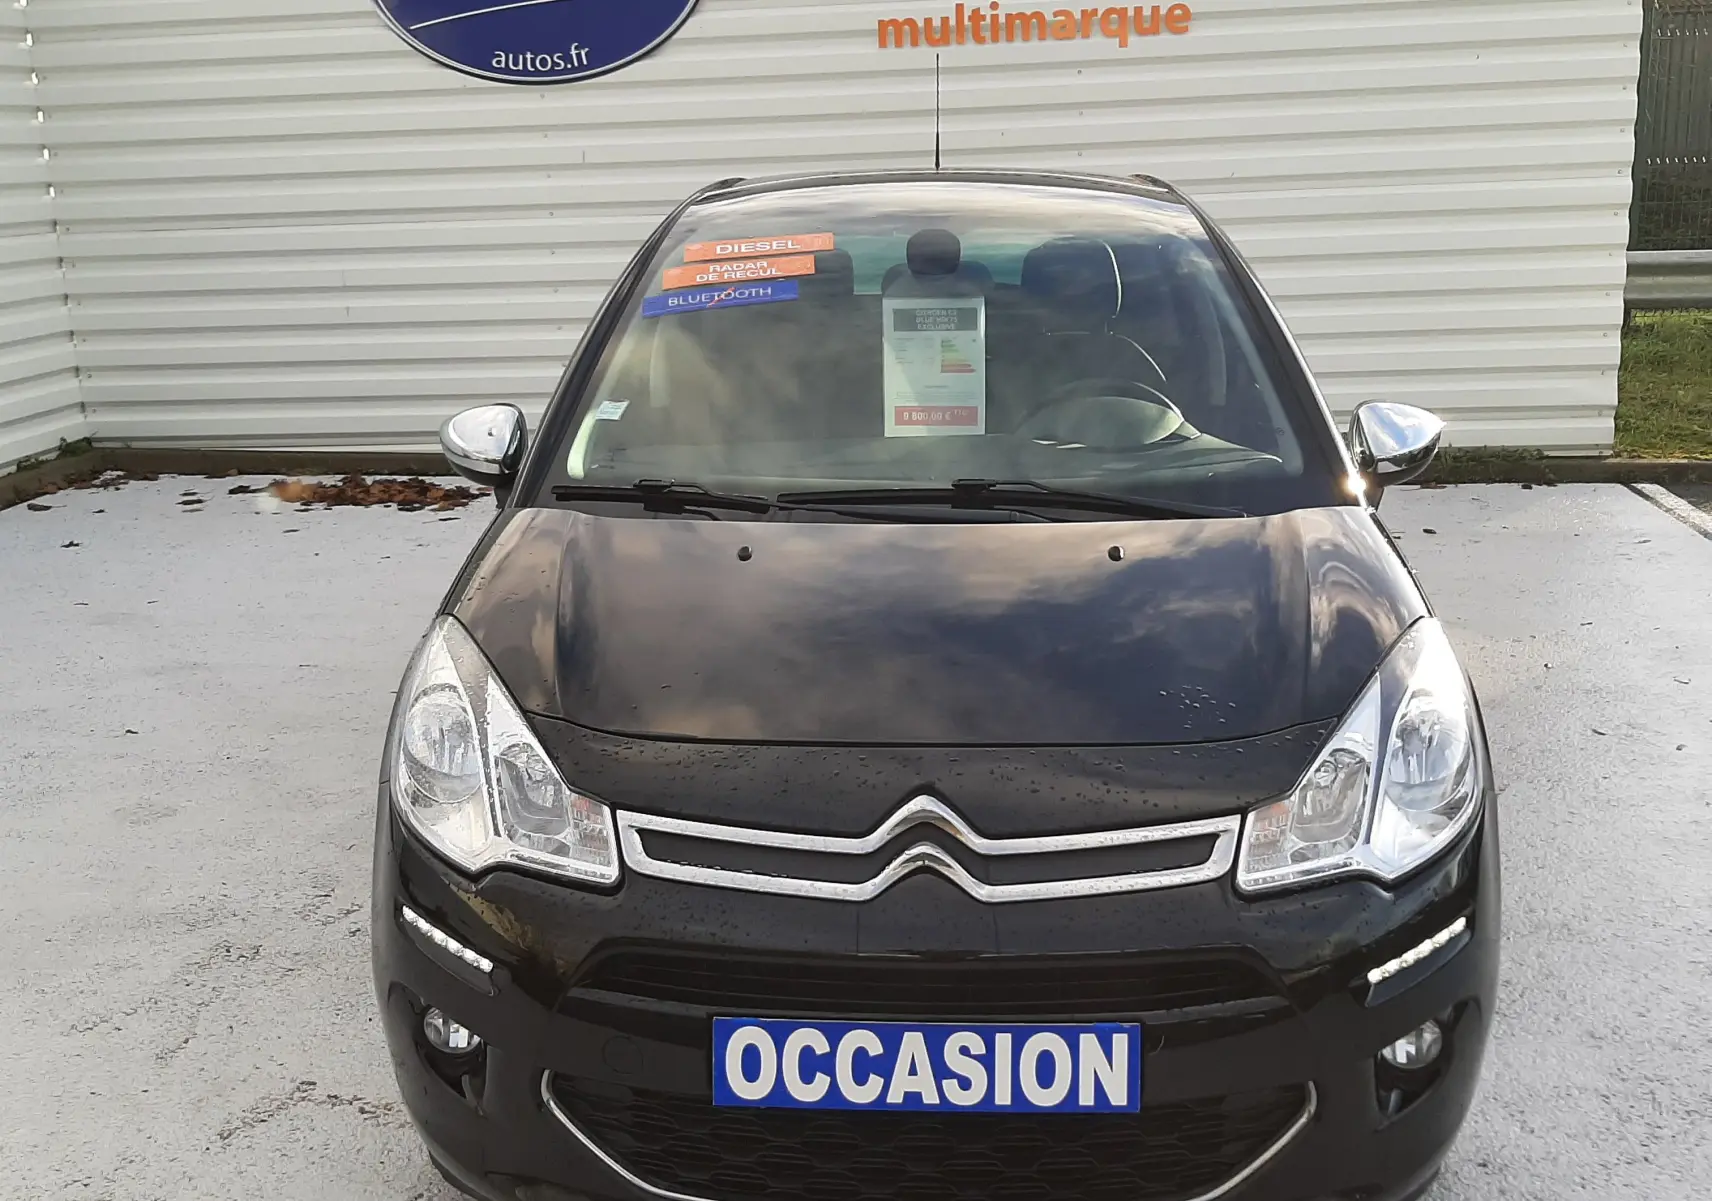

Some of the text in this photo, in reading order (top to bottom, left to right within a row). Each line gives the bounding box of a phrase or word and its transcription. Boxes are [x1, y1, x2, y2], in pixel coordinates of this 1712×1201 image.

[877, 1, 1193, 48] multimarque
[491, 42, 590, 71] autos.fr
[715, 240, 801, 254] DIESEL
[696, 267, 783, 282] DE RECUL
[709, 260, 768, 273] RADAR
[668, 287, 772, 307] BLUETOOTH
[725, 1025, 1129, 1107] OCCASION
